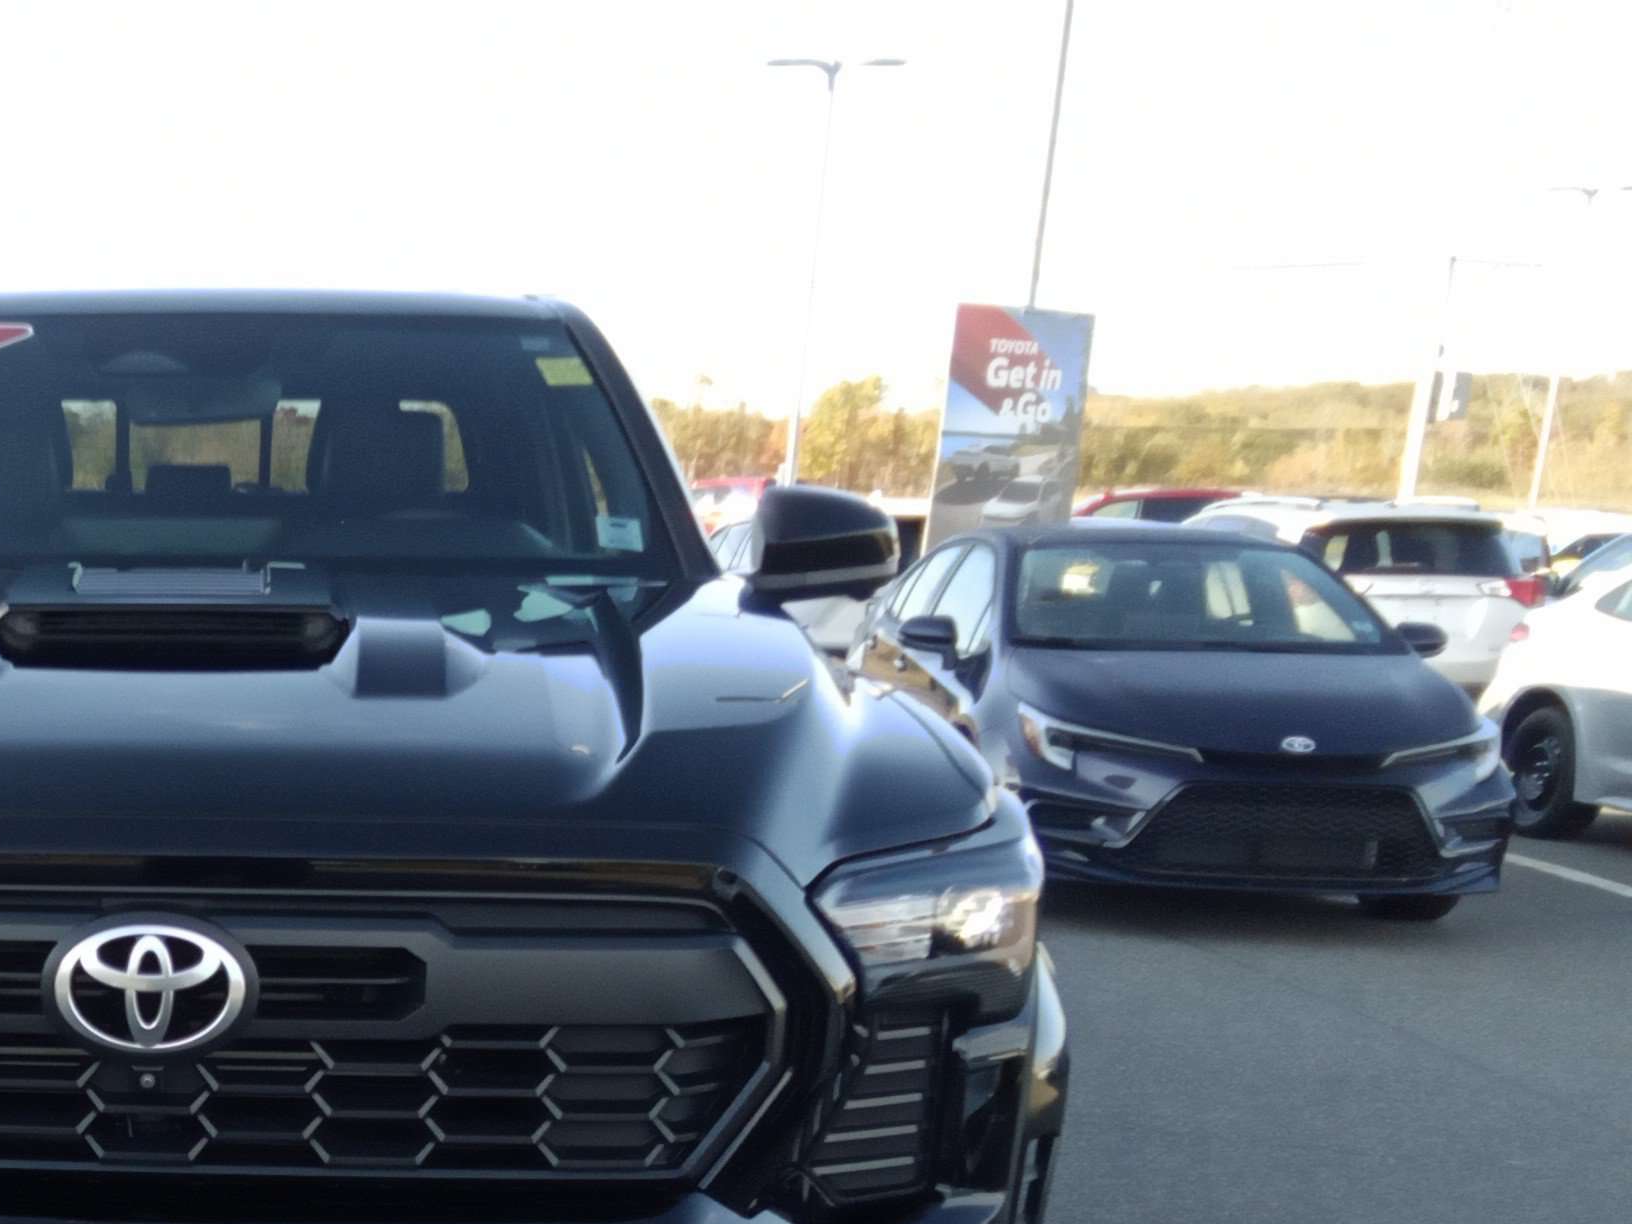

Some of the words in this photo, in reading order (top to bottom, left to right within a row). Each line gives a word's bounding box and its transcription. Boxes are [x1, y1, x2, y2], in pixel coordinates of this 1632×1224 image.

[989, 338, 1039, 355] TOYOTA
[986, 356, 1037, 389] Get
[1039, 359, 1062, 391] in
